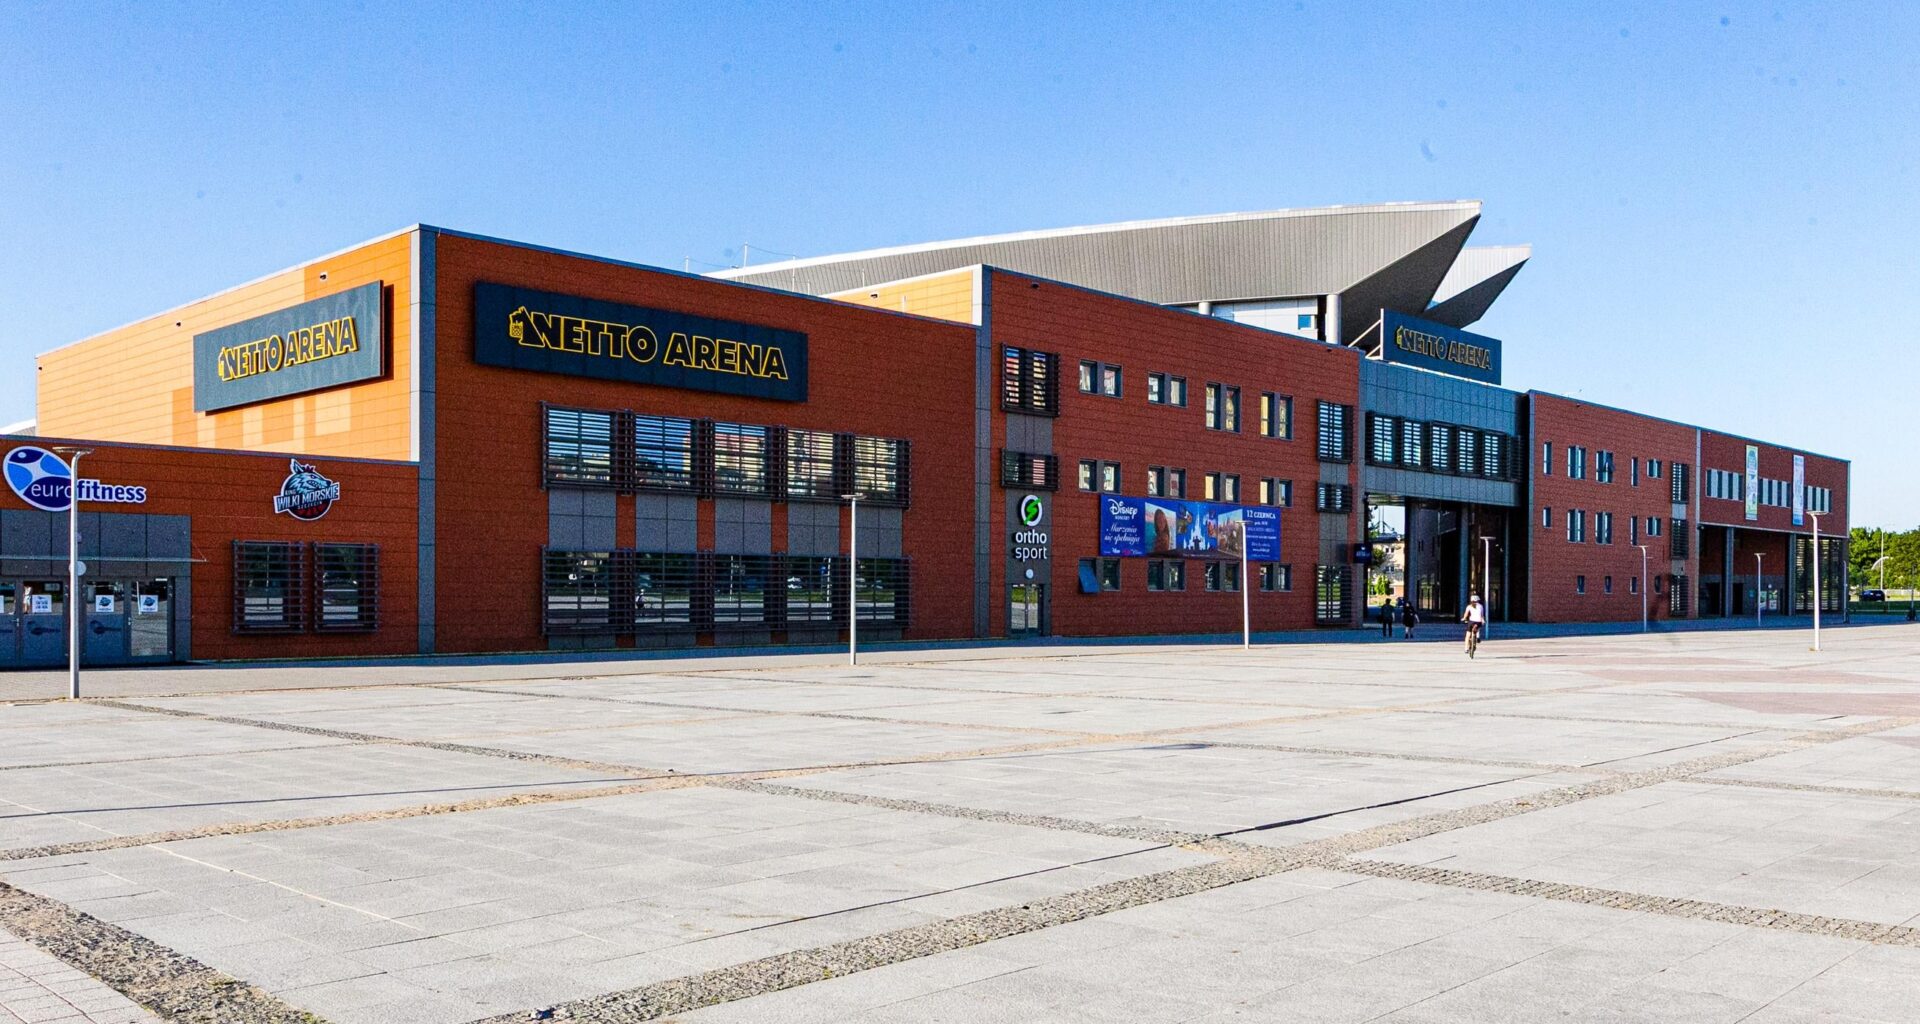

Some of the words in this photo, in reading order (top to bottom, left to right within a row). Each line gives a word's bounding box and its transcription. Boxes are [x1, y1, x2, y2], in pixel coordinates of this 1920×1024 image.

[221, 335, 284, 382] NETTO
[284, 316, 358, 367] ARENA
[518, 308, 658, 363] NETTO
[664, 333, 788, 380] ARENA
[1400, 328, 1447, 360] NETTO
[1448, 340, 1492, 370] ARENA
[277, 495, 300, 512] WILKI
[302, 484, 338, 505] MORSKIE
[1247, 510, 1253, 518] 12
[1015, 529, 1047, 544] ortho
[1015, 547, 1047, 562] sport
